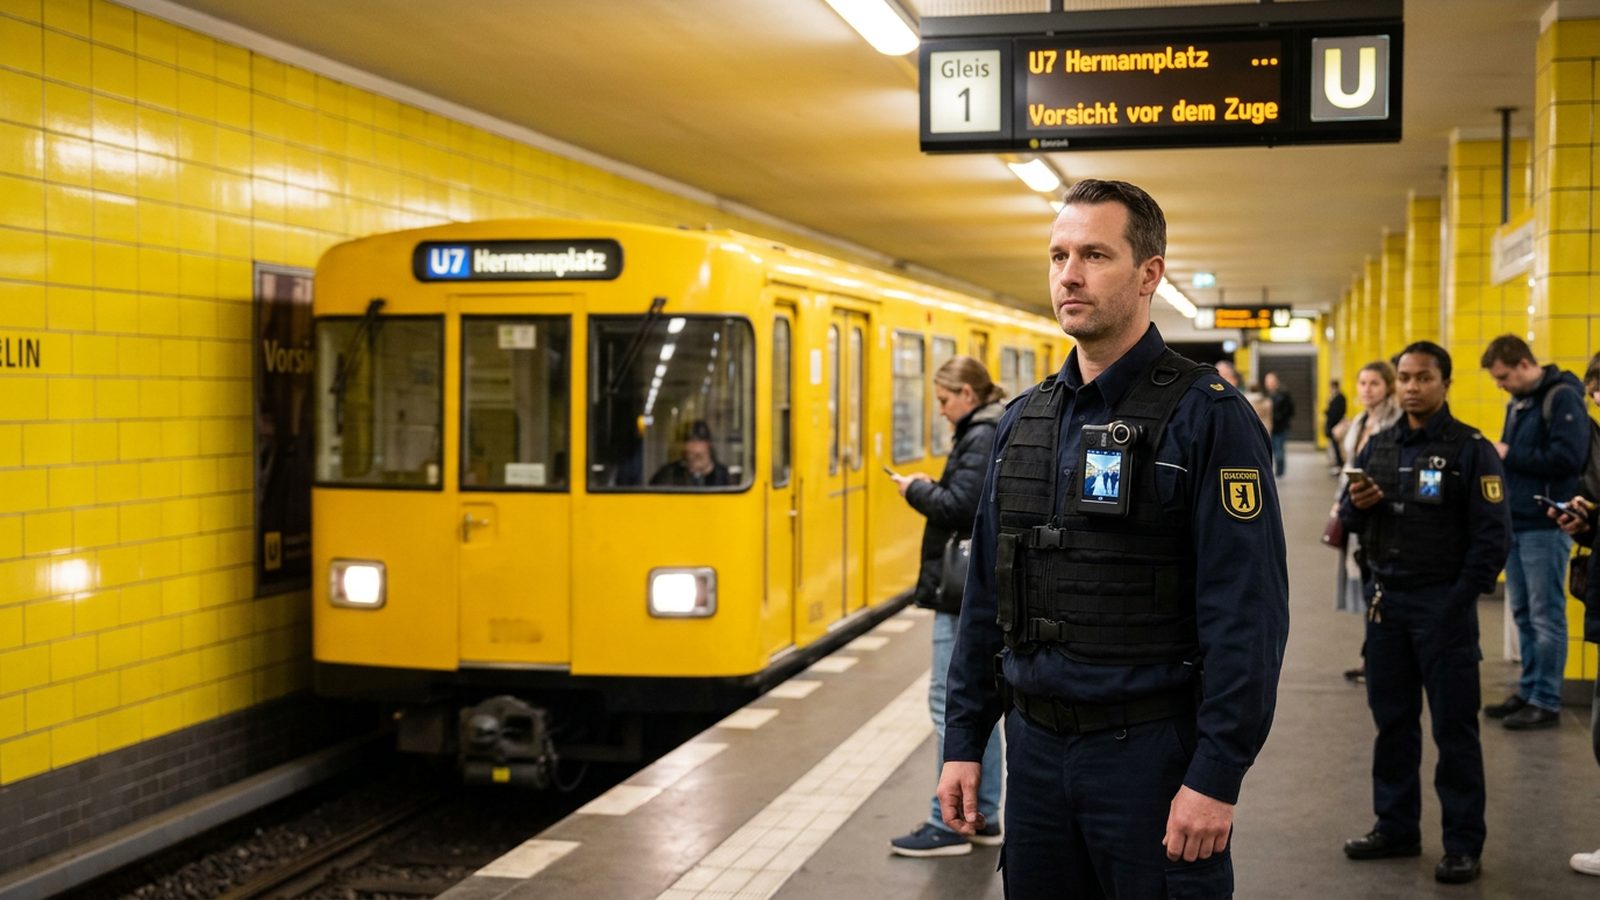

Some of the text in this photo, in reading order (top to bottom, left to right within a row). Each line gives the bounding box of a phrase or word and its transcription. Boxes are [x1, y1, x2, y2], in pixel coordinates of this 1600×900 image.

[941, 59, 990, 80] Gleis
[1028, 50, 1057, 75] U7
[1065, 45, 1209, 75] Hermannplatz
[1324, 47, 1376, 109] U
[957, 87, 971, 122] 1
[1028, 97, 1279, 126] Vorsicht vor dem Zuge
[430, 247, 607, 278] U7 Hermannplatz
[0, 336, 41, 369] LIN
